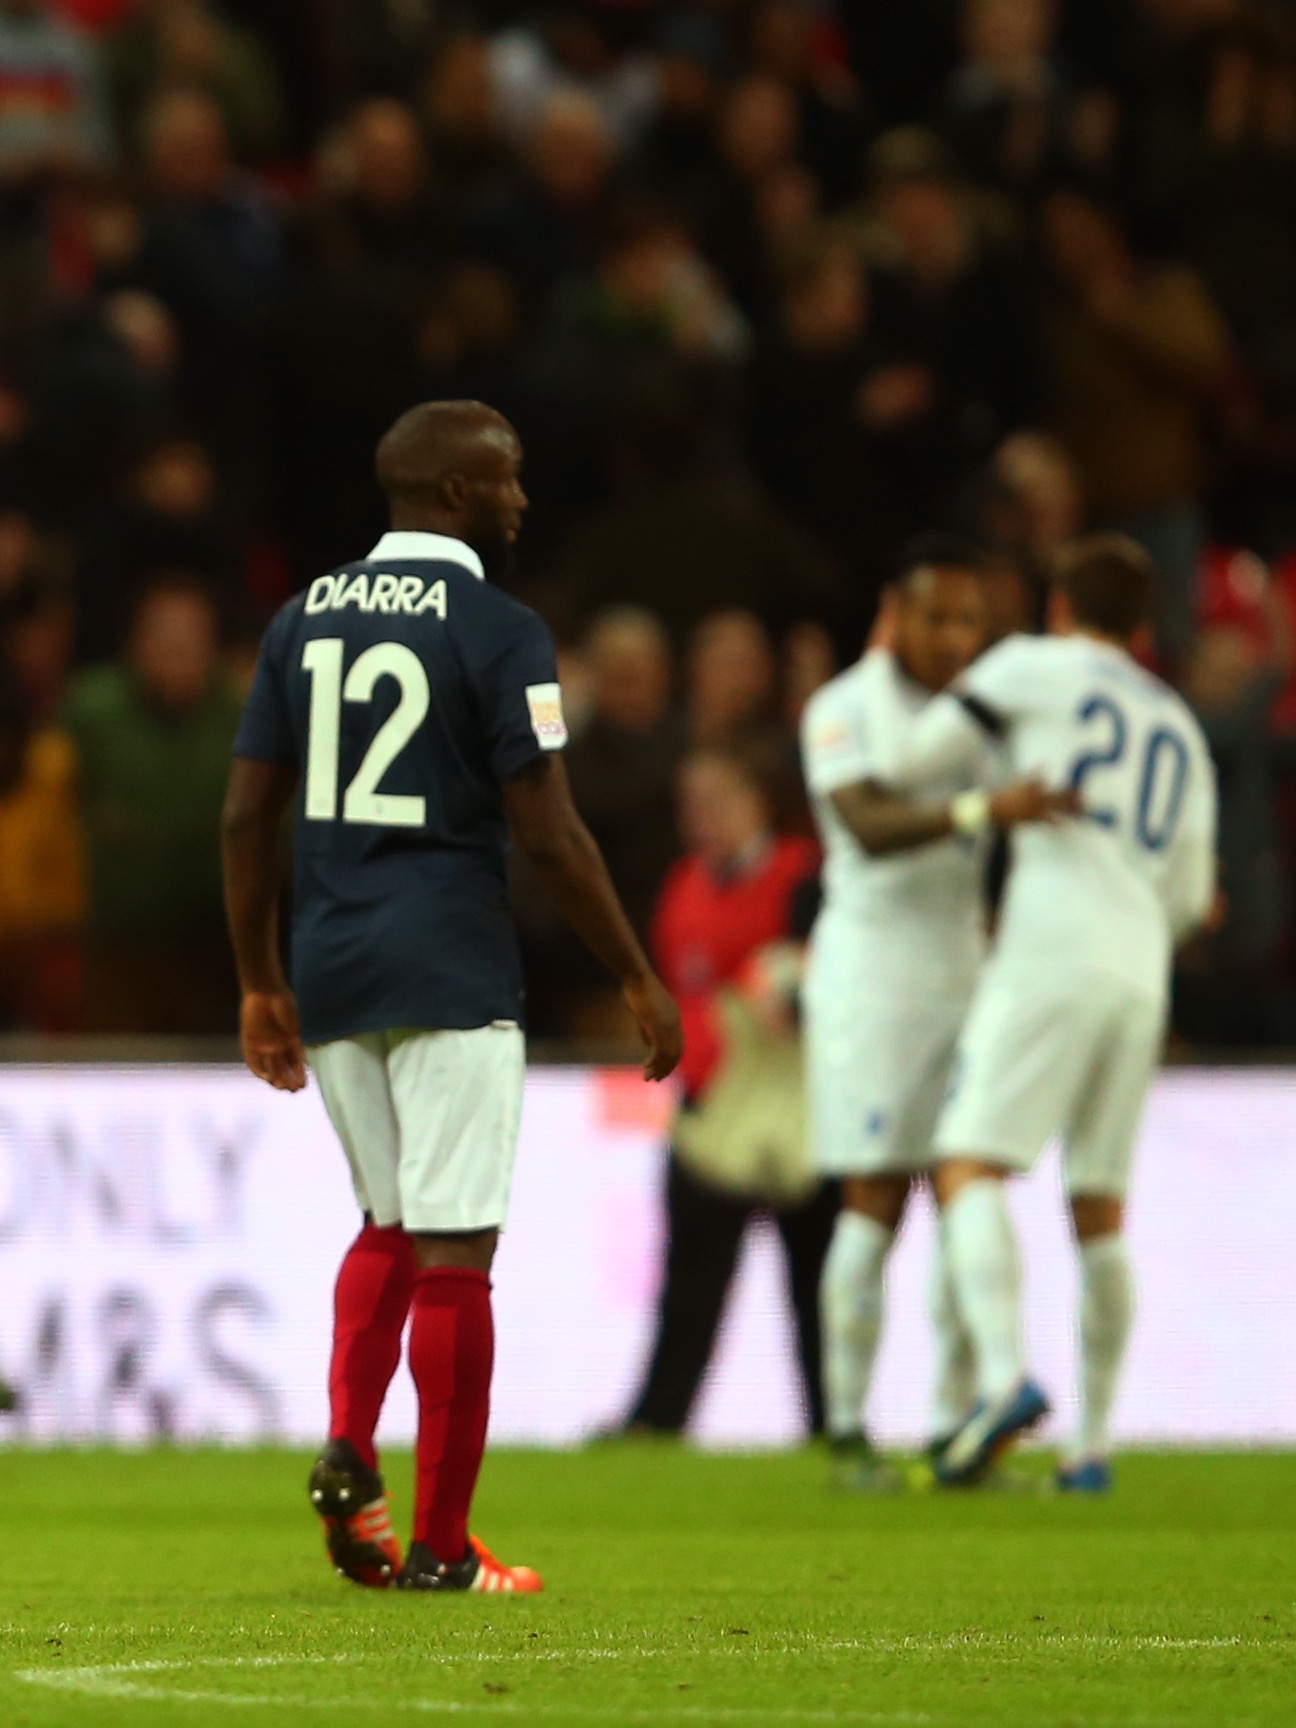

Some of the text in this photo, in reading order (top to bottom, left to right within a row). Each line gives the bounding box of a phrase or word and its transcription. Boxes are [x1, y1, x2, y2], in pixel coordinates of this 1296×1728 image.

[305, 573, 448, 620] DIARRA
[302, 637, 430, 828] 12
[1070, 694, 1189, 852] 20
